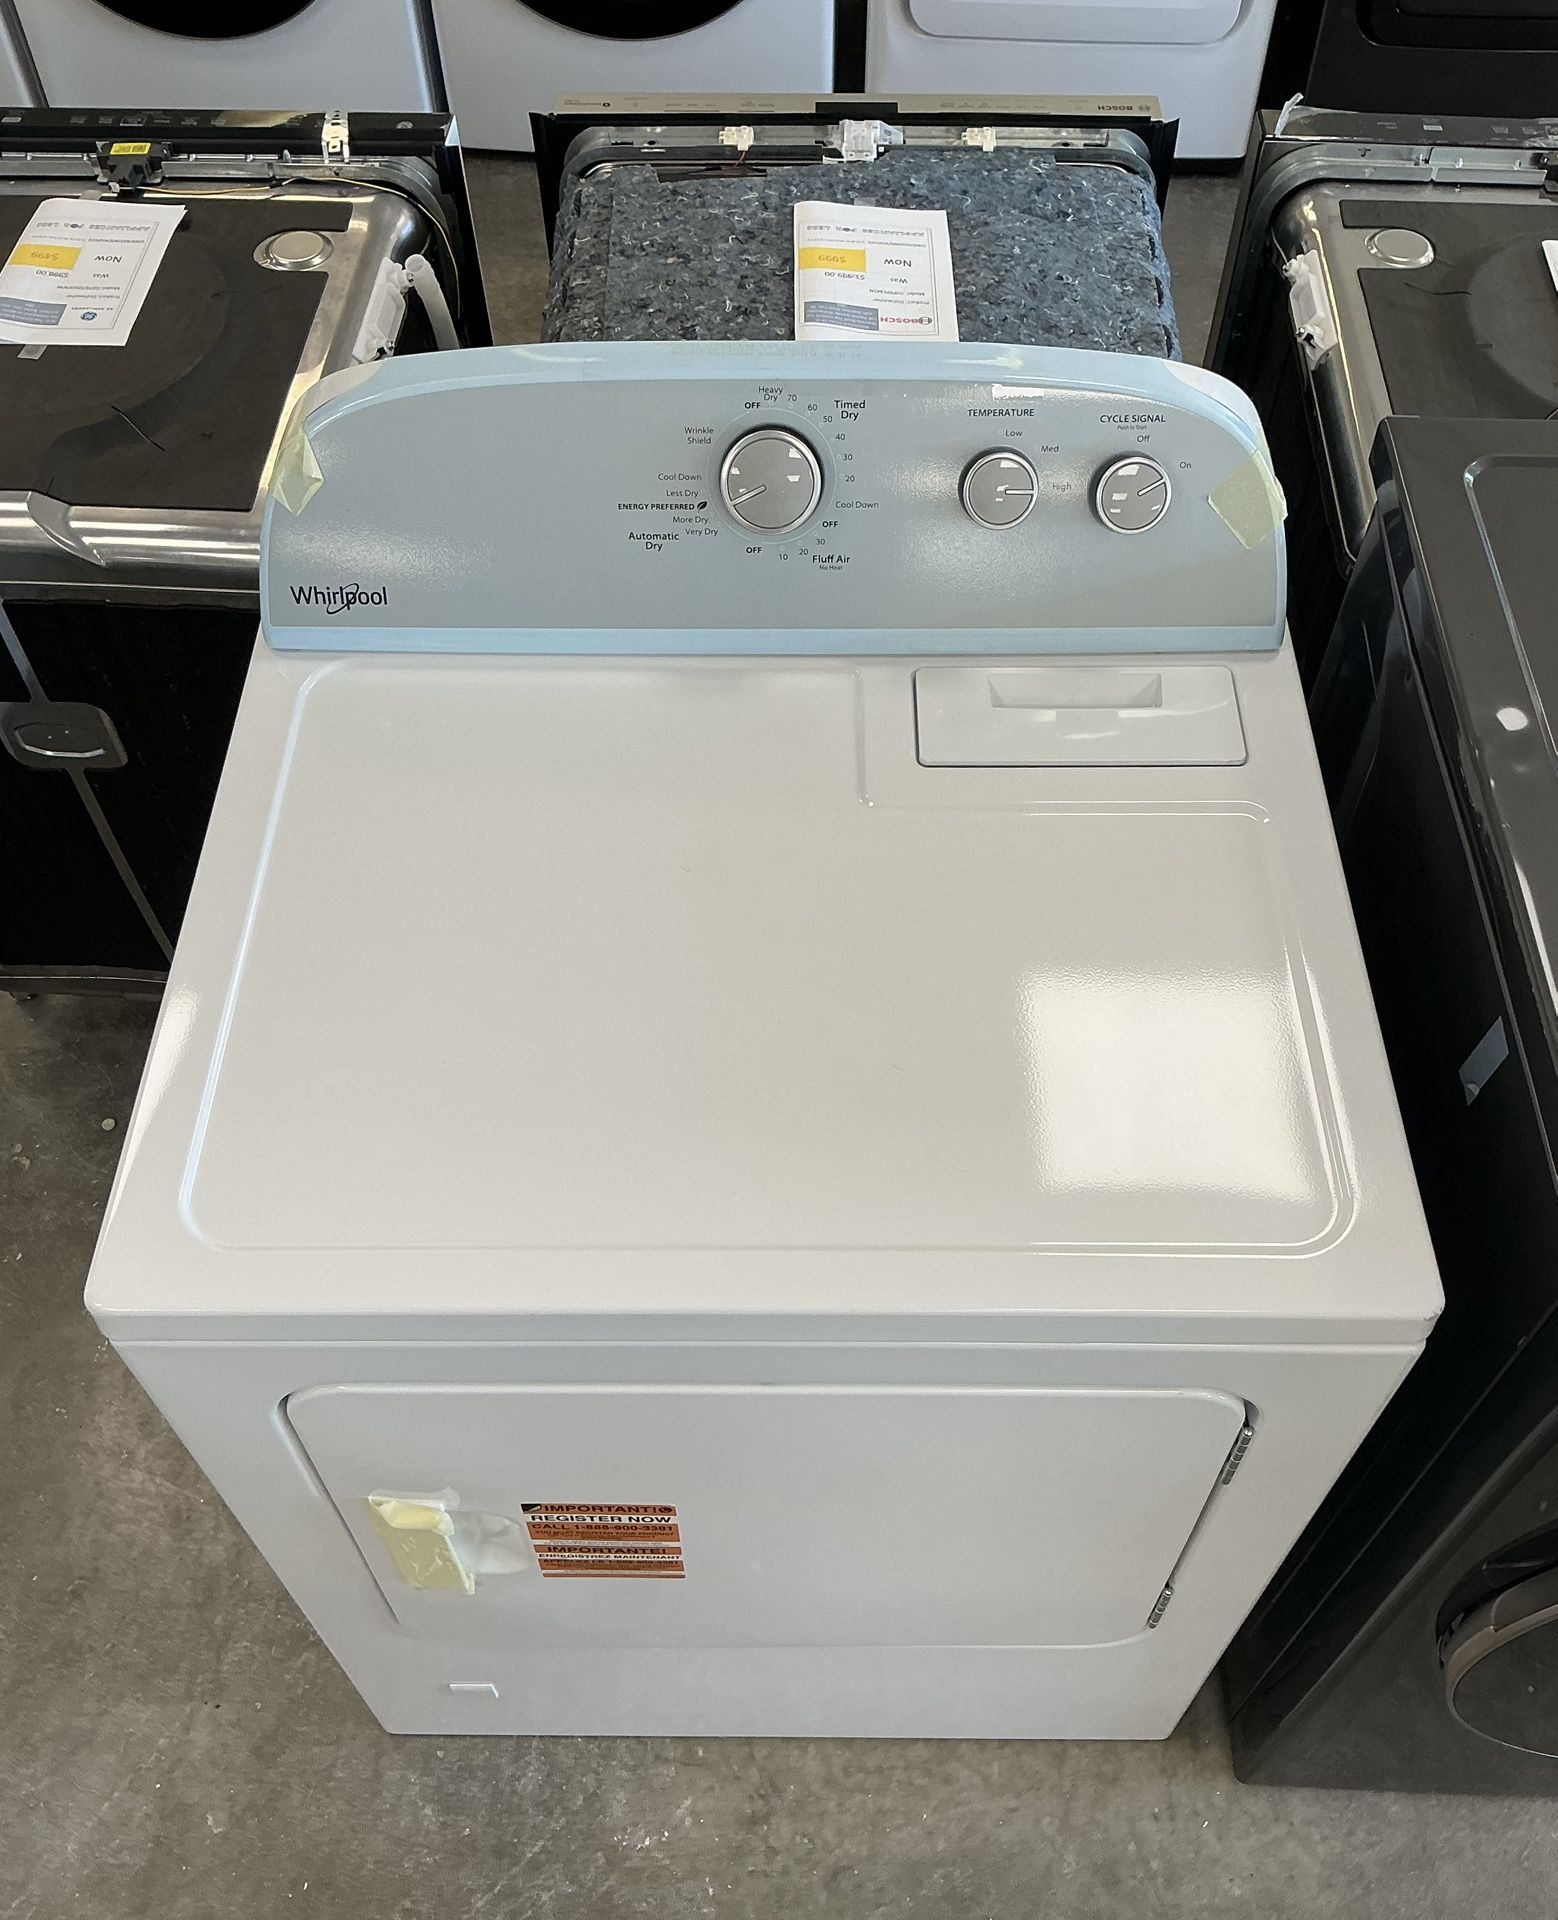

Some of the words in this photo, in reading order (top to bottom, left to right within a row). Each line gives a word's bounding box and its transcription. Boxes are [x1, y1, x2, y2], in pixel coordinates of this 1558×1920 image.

[31, 252, 59, 261] $499
[818, 255, 847, 263] $999
[884, 259, 912, 267] Now
[758, 386, 784, 394] Heavy
[788, 394, 797, 402] 70
[834, 400, 866, 409] Timed
[841, 411, 859, 421] Dry
[968, 409, 1035, 417] TEMPERATURE
[1100, 415, 1129, 423] CYCLE
[1131, 415, 1166, 423] SIGNAL
[835, 433, 846, 441] 40
[1005, 430, 1023, 438] Low
[688, 437, 712, 445] Shield
[1137, 435, 1151, 443] Off
[1041, 445, 1060, 453] Med
[658, 473, 677, 481] Cool
[679, 473, 702, 481] Down
[1052, 483, 1072, 491] High
[685, 490, 699, 499] Dry
[618, 503, 649, 511] ENERGY
[651, 503, 695, 511] PREFERRED
[835, 501, 854, 509] Cool
[856, 501, 879, 509] Down
[673, 516, 694, 524] More
[695, 516, 709, 525] Dry
[629, 532, 680, 541] Automatic
[685, 528, 703, 537] Very
[705, 528, 719, 537] Dry
[645, 542, 663, 552] Dry
[812, 555, 835, 564] Fluff
[836, 555, 851, 564] Air
[290, 584, 387, 613] Whirlpool
[544, 1505, 657, 1514] IMPORTANT!
[531, 1515, 622, 1523] REGISTER
